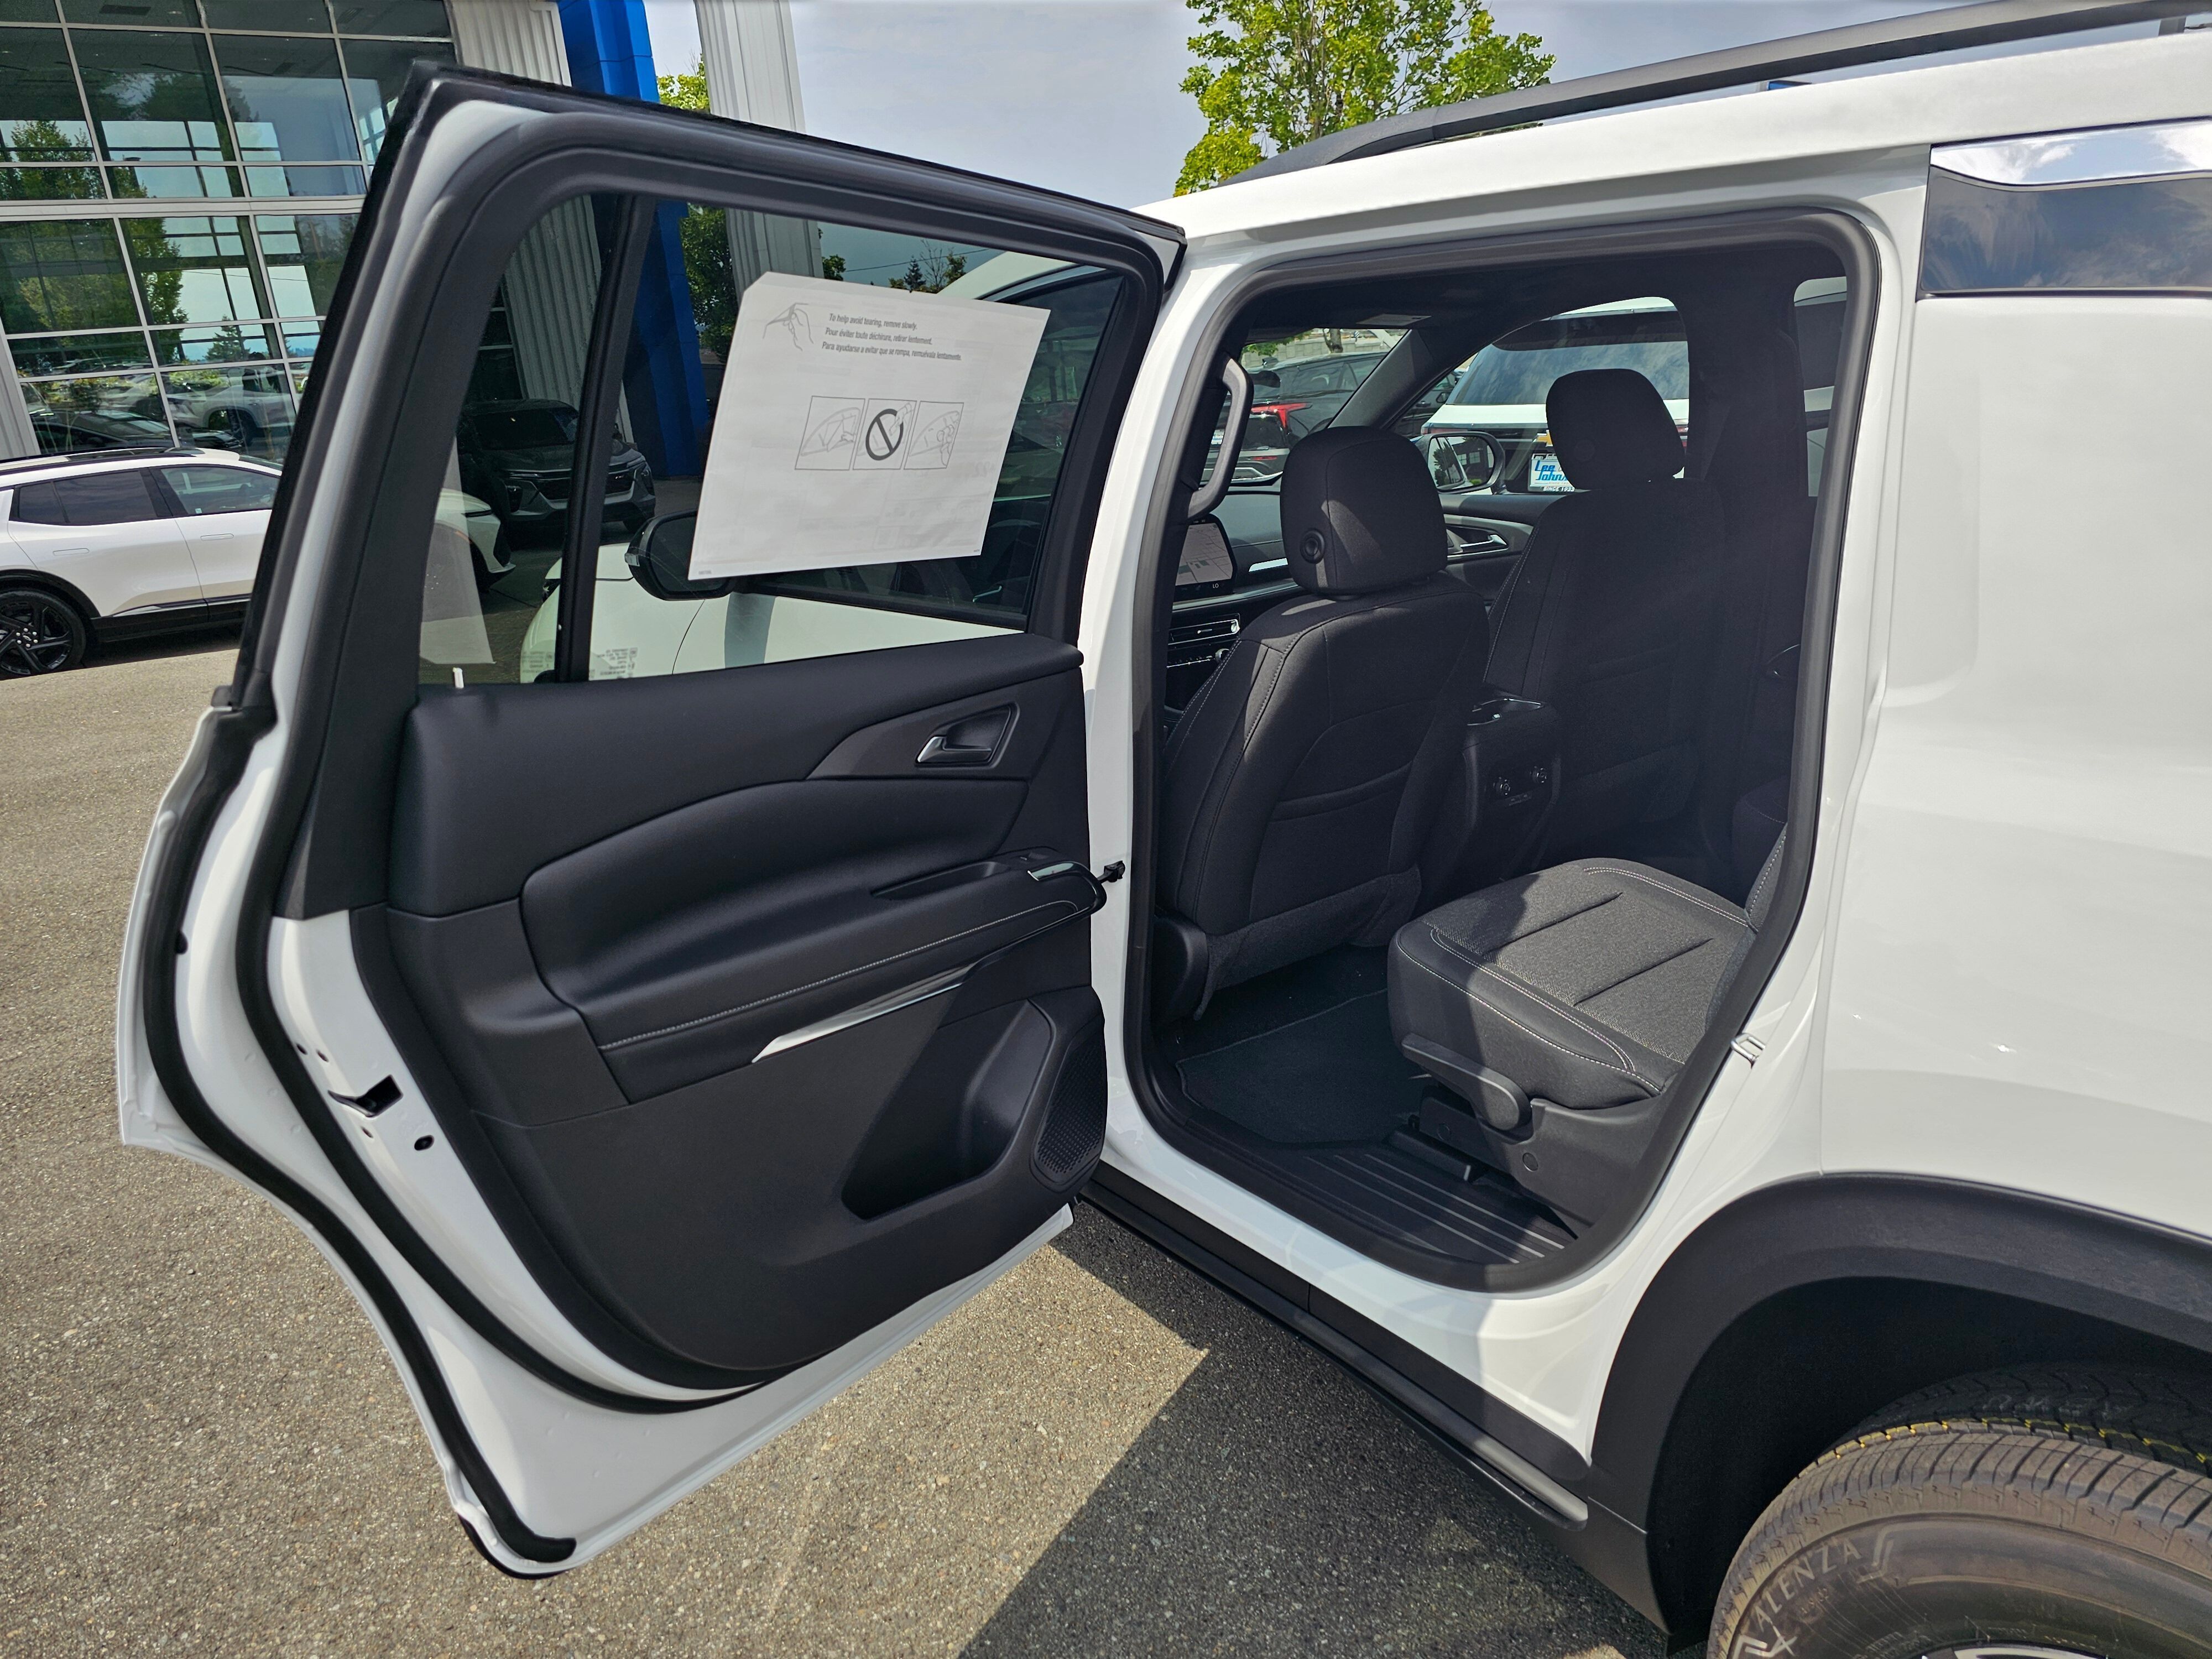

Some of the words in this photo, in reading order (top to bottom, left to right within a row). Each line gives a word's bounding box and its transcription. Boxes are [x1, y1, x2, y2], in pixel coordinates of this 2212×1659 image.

[830, 313, 836, 321] To
[837, 314, 849, 324] help
[864, 318, 882, 327] tearing,
[901, 321, 917, 331] slowly.
[825, 327, 838, 336] Pour
[839, 328, 854, 338] éviter
[855, 331, 868, 339] toute
[822, 341, 834, 350] Para
[836, 343, 860, 352] ayudarse
[1535, 460, 1556, 471] Lee
[1754, 1538, 1862, 1632] ALENZA
